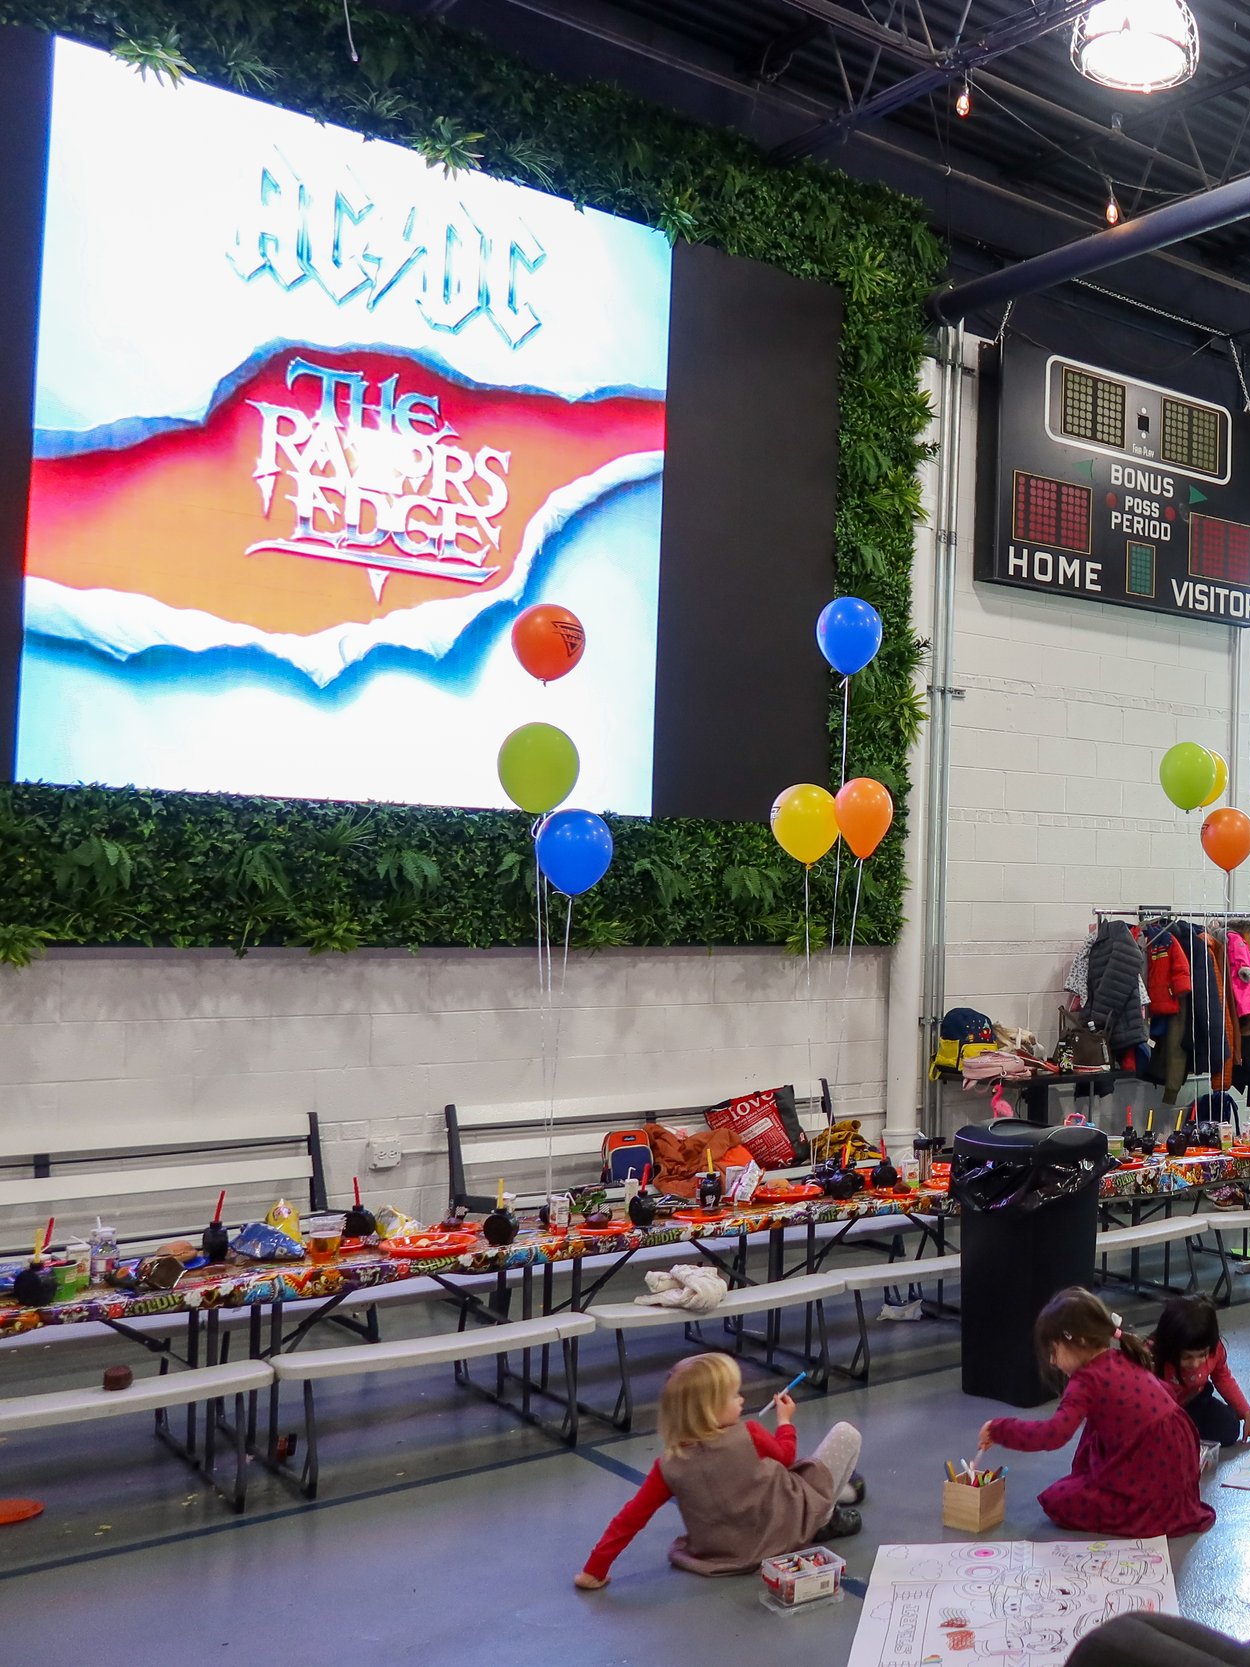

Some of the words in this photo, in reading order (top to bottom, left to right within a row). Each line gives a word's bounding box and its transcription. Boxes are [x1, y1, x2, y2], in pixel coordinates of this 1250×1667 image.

[286, 356, 458, 438] THE
[245, 399, 511, 519] RAORS
[1110, 463, 1175, 499] BONUS
[1111, 510, 1171, 541] PERIOD
[1124, 495, 1160, 518] POSS
[1008, 545, 1102, 592] HOME
